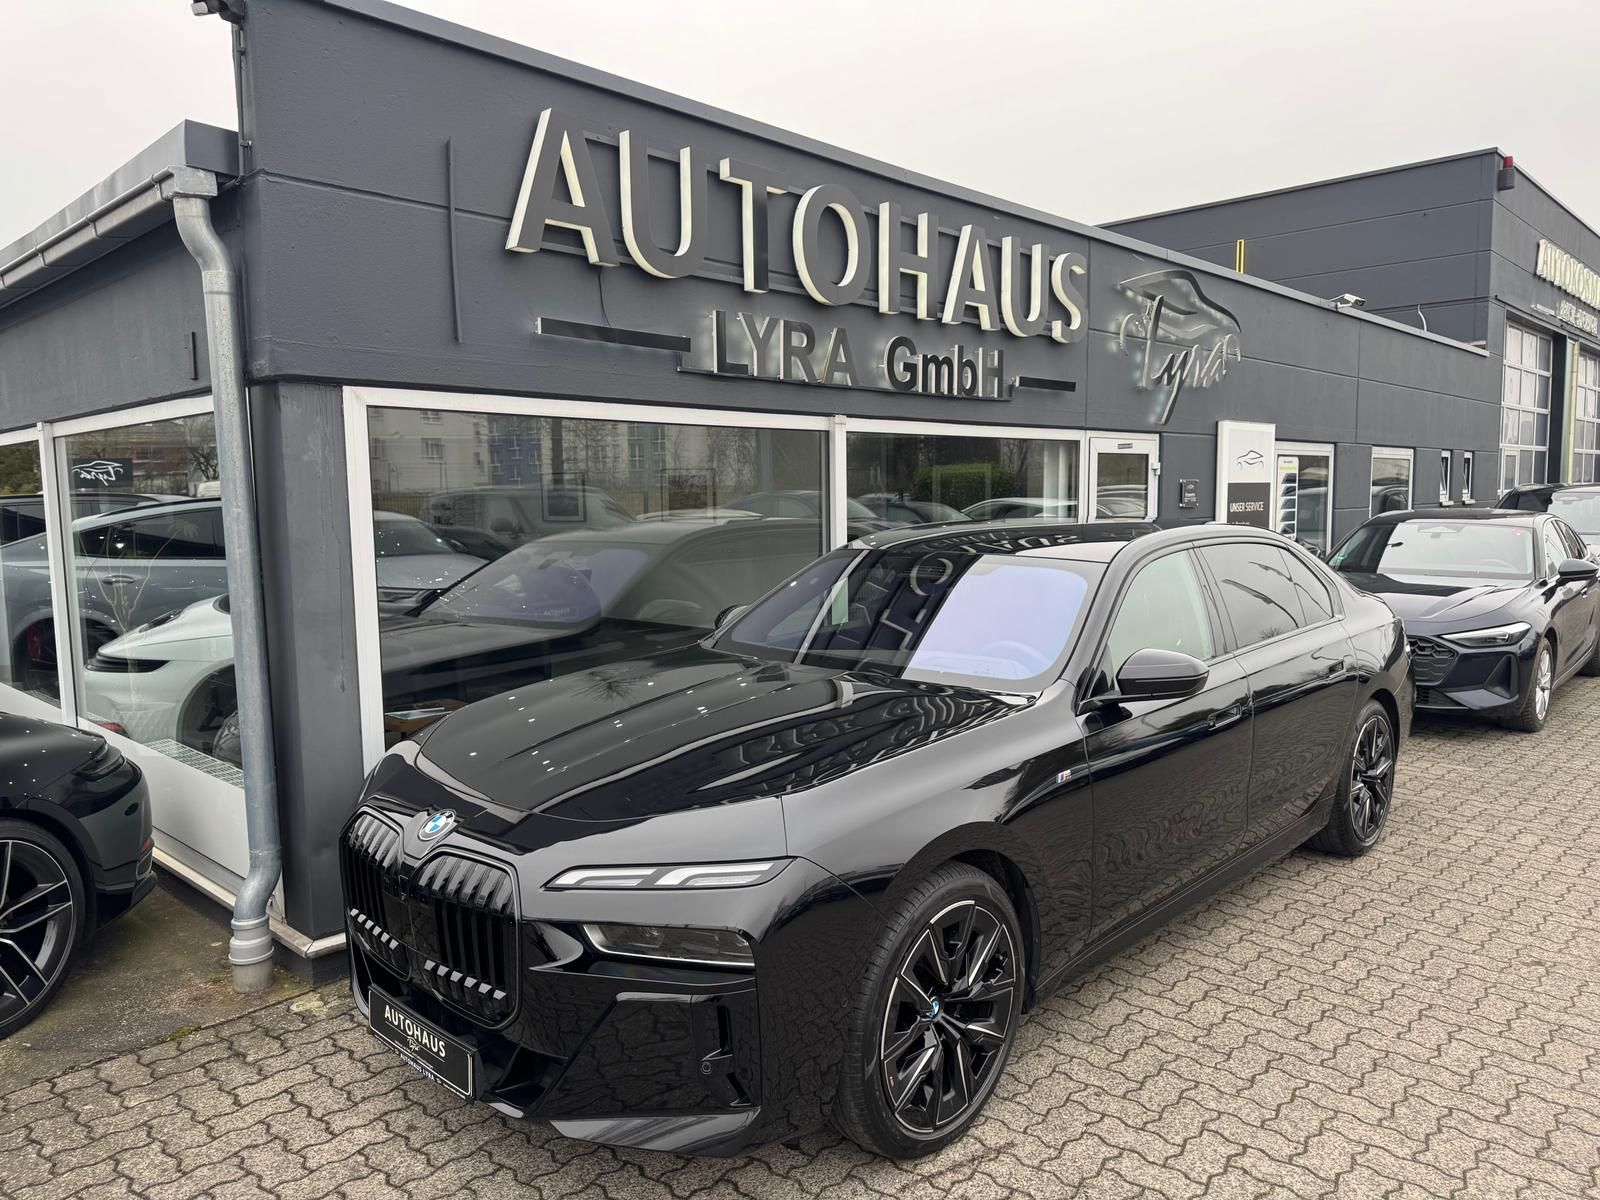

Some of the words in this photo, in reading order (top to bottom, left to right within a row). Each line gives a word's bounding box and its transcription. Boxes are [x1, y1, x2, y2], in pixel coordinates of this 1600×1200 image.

[505, 107, 1087, 344] AUTOHAUS
[710, 308, 861, 386] LYRA
[882, 334, 1004, 399] GmbH
[1229, 502, 1246, 513] UNSER
[1245, 501, 1265, 512] SERVICE
[384, 1005, 446, 1057] AUTOHAUS
